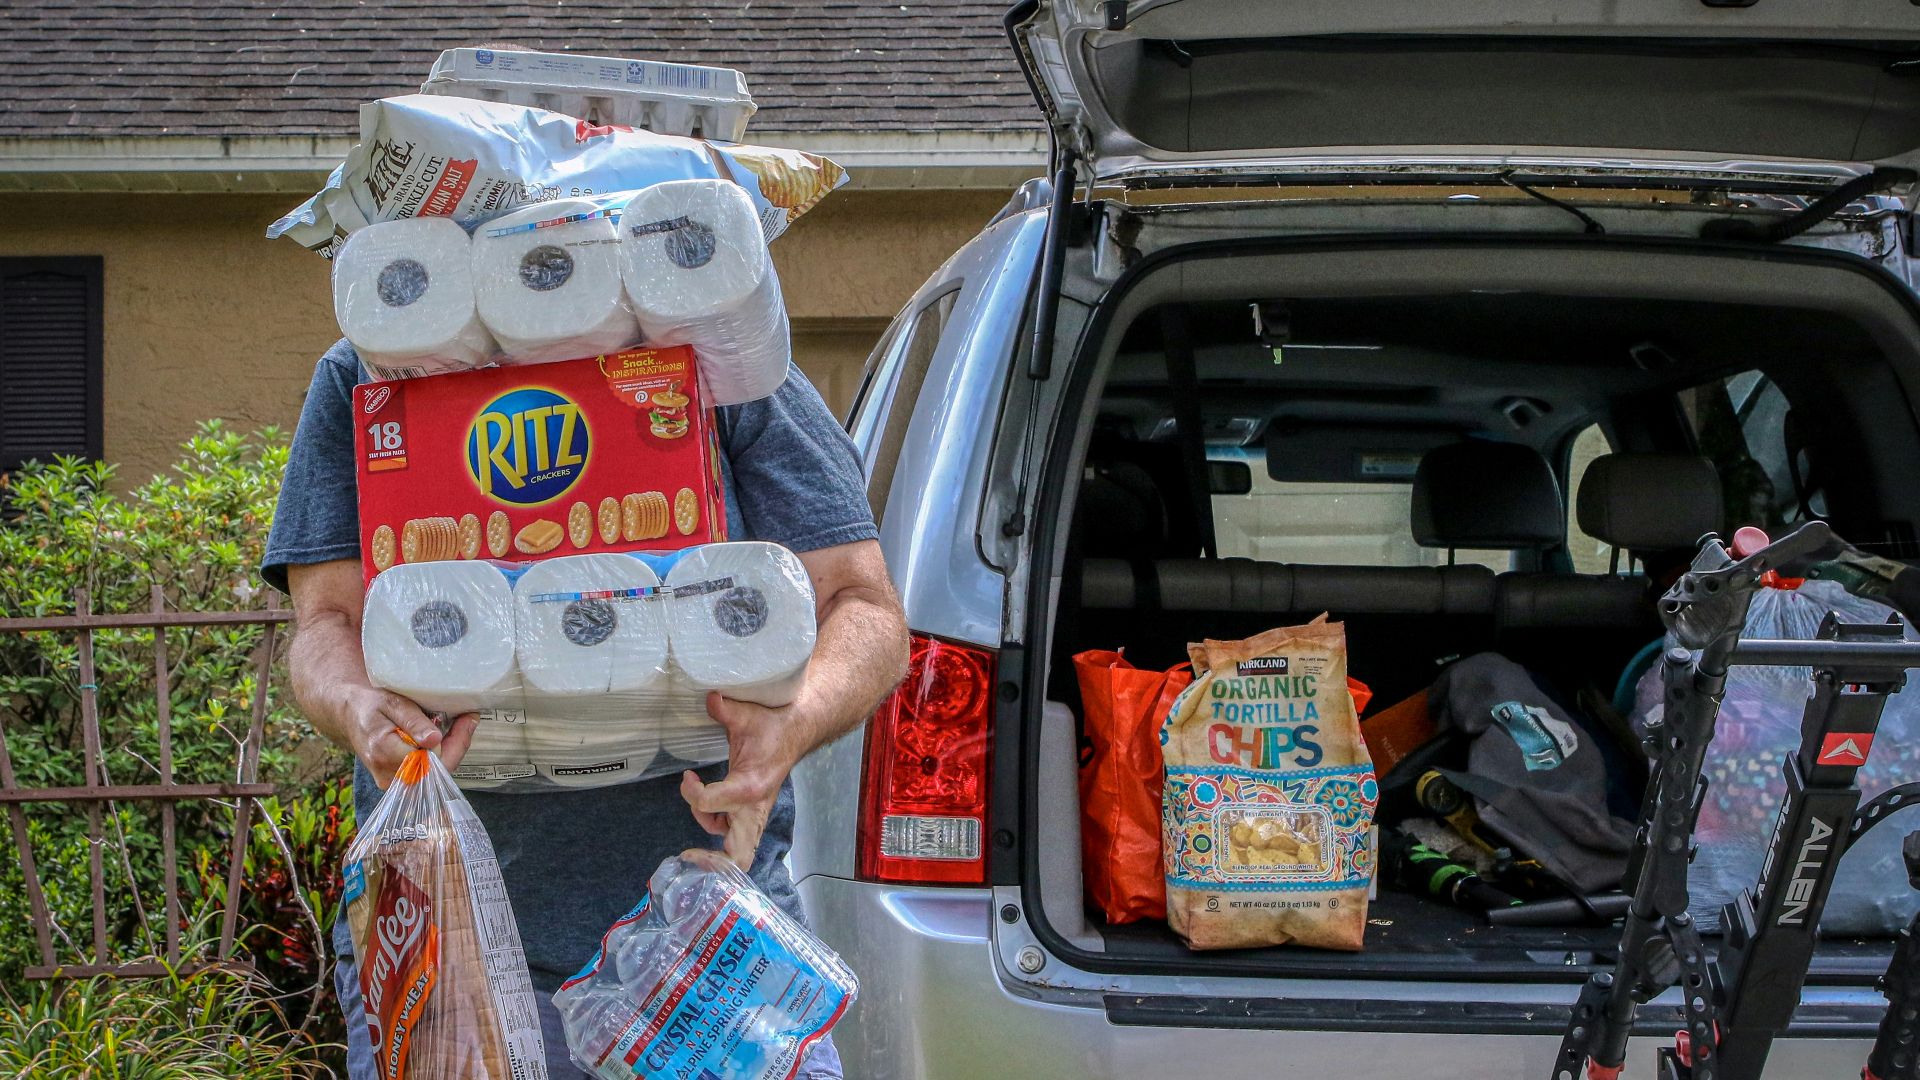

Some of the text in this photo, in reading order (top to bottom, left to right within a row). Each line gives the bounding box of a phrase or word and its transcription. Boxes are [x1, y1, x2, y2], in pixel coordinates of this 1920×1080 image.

[393, 173, 416, 203] BRAND
[442, 167, 464, 191] SALT
[484, 179, 507, 211] PROMISE
[622, 356, 654, 368] Snack
[367, 388, 388, 412] NABISCO
[368, 421, 403, 450] 18
[475, 404, 582, 496] RITZ
[530, 468, 571, 484] CRACKERS
[1240, 658, 1287, 669] KIRKLAND
[1211, 675, 1317, 700] ORGANIC
[1211, 701, 1319, 724] TORTILLA
[1208, 723, 1323, 770] CHIPS
[557, 764, 622, 776] KIRKLAND
[1778, 817, 1833, 925] ALLEN
[1271, 901, 1277, 909] (2
[1292, 901, 1300, 909] oz)
[643, 1004, 672, 1043] BOTTLED
[670, 989, 683, 1002] AT
[681, 969, 698, 987] THE
[698, 936, 722, 971] SOURCE
[646, 1002, 705, 1072] CRYSTAL
[696, 928, 755, 1004] GEYSER
[707, 998, 743, 1044] SPRING
[740, 957, 771, 1001] WATER
[389, 971, 430, 1079] HONEY WHEAT
[686, 978, 743, 1052] NATURAL
[720, 1040, 728, 1049] BY
[725, 1031, 735, 1042] CG
[769, 1063, 777, 1071] FL
[774, 1056, 782, 1065] OZ
